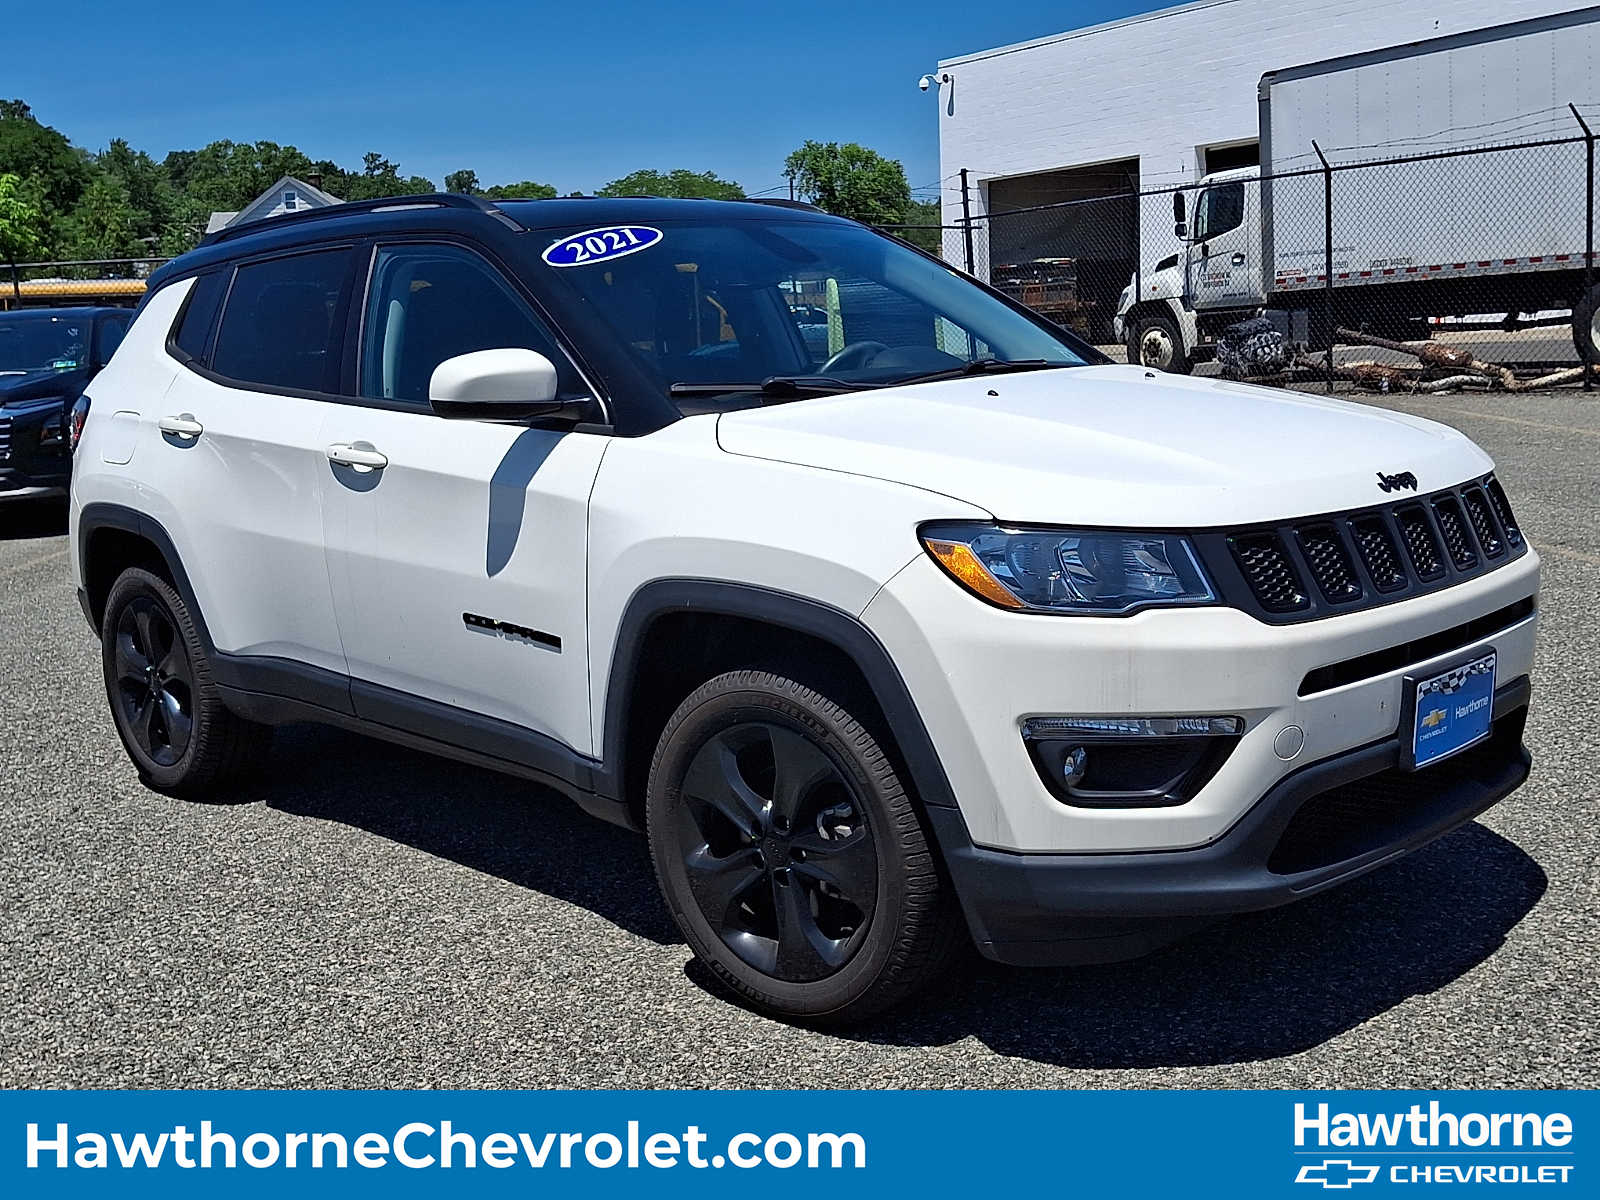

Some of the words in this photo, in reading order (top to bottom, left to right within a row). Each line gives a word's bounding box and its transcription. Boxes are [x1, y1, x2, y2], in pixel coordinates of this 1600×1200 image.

[565, 228, 642, 262] 2021
[1375, 471, 1418, 493] Jeep
[1455, 696, 1489, 720] Hawthorne
